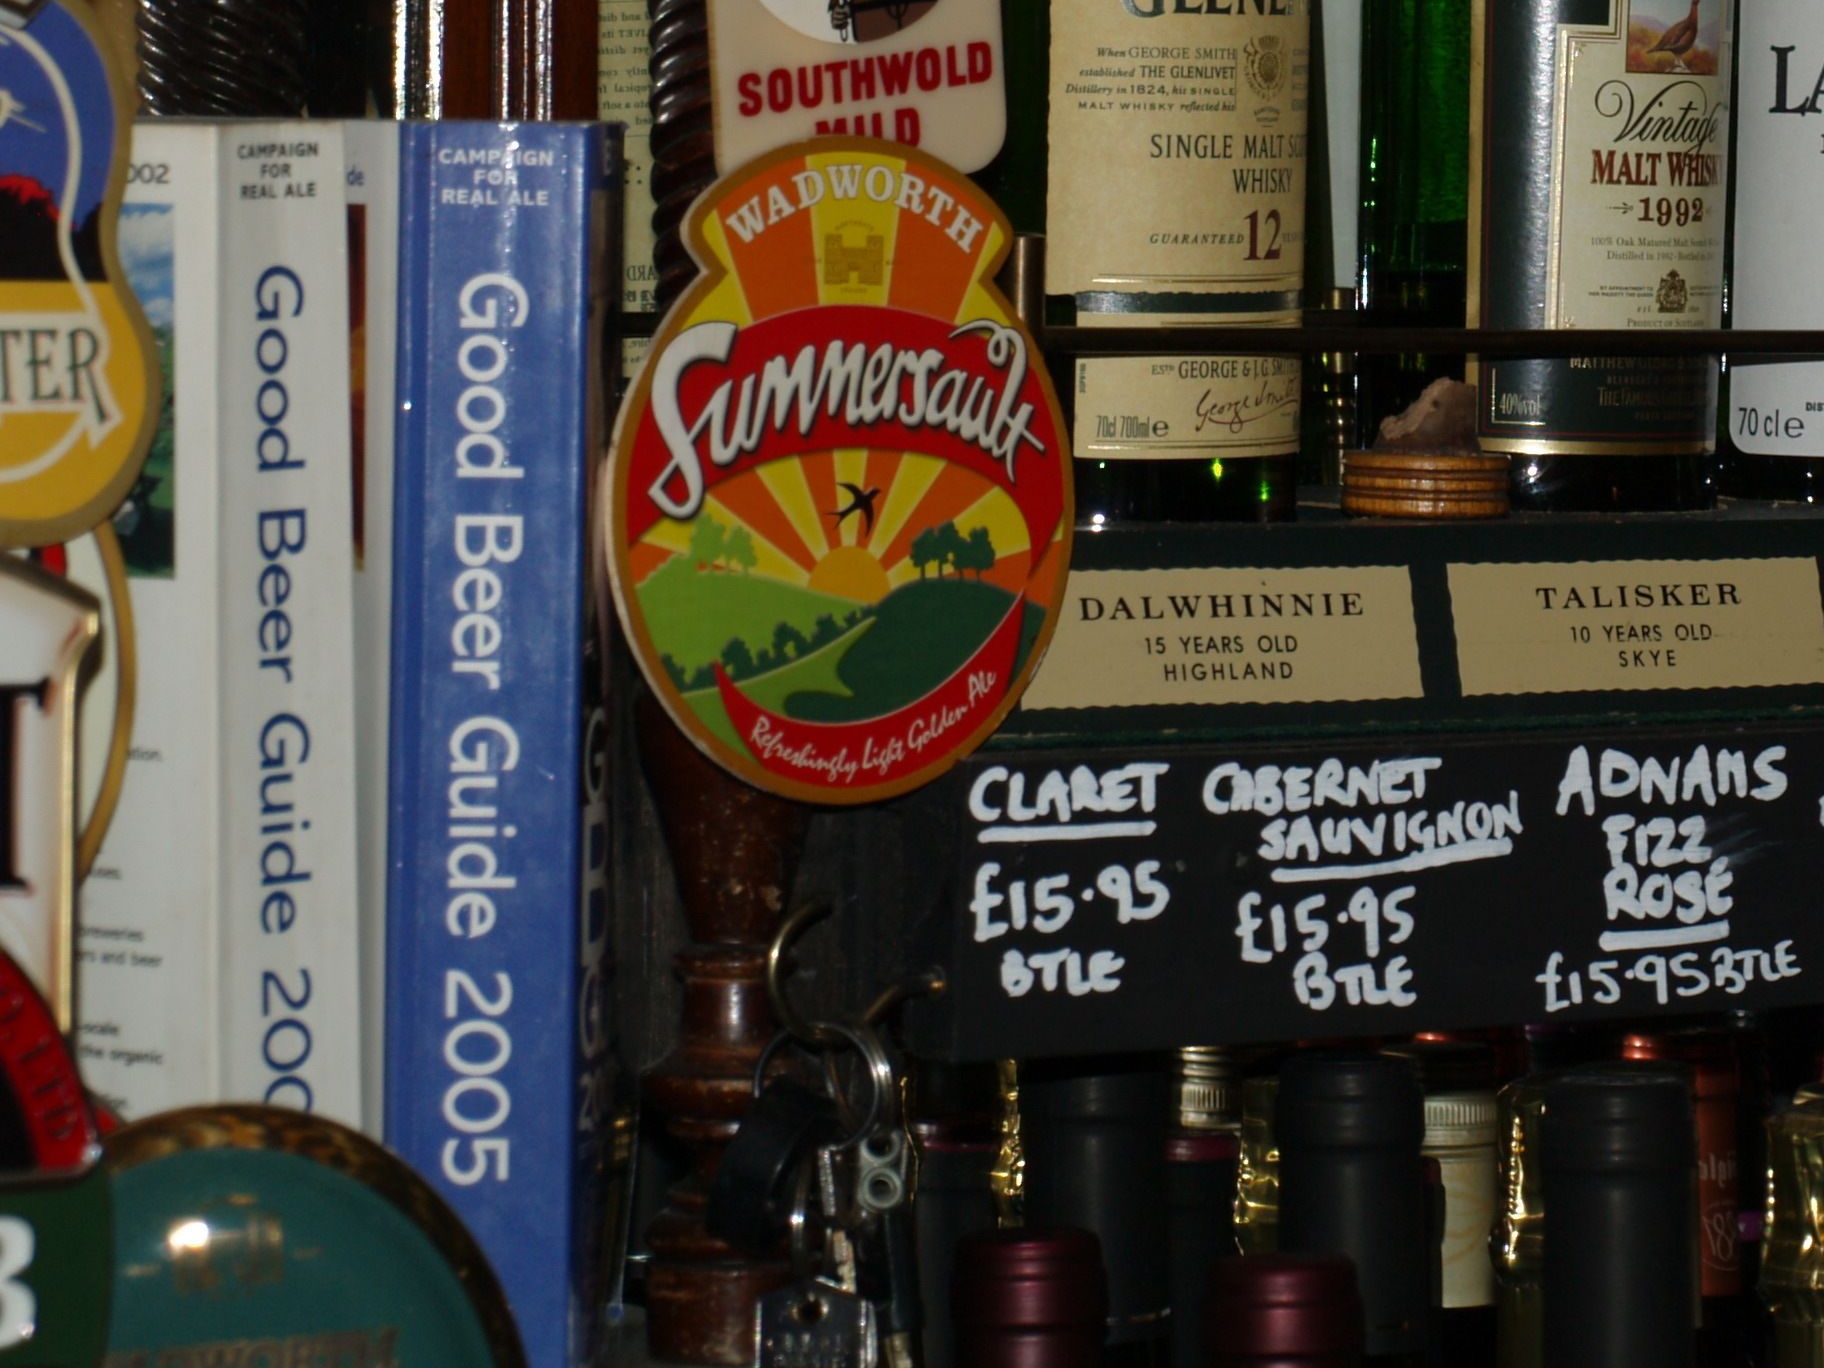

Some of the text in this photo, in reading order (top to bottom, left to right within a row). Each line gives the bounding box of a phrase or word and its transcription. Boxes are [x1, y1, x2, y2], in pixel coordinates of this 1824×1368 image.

[738, 41, 994, 117] SOUTHWOLD
[1128, 47, 1236, 59] GEORGE SMITH
[1140, 66, 1236, 79] THE GLENLIVET
[1595, 79, 1720, 153] Vintage
[439, 150, 553, 167] CAMPAIGN
[1150, 134, 1284, 159] SINGLE MALT
[1591, 149, 1660, 185] MALT
[442, 189, 549, 207] REAL ALE
[474, 169, 517, 184] FOR
[1233, 168, 1294, 193] WHISKY
[725, 164, 984, 253] WADWORTH
[1150, 209, 1282, 261] GUARANTEED 12
[1638, 196, 1705, 227] 1992
[647, 319, 1046, 519] Summersault
[256, 264, 311, 933] Good Beer Guide
[1080, 592, 1364, 621] DALWHINNIE
[1536, 582, 1740, 609] TALISKER
[1144, 633, 1298, 654] 15 YEARS OLD
[1570, 622, 1712, 643] 10 YEARS OLD
[1619, 649, 1677, 668] SKYE
[1162, 659, 1293, 681] HIGHLAND
[442, 272, 529, 1185] Good Beer Guide 2005
[749, 670, 998, 781] Refreshingly Light Golden Ale
[969, 762, 1169, 822] CLARET
[1203, 758, 1441, 815] CABERNET
[1556, 744, 1788, 816] ADNAMS
[1257, 791, 1523, 862] SAUVIGNON
[1602, 813, 1712, 867] FIZZ
[969, 860, 1169, 942] £15.95
[1602, 856, 1734, 923] ROSÉ
[1235, 885, 1416, 963] £15.95
[1000, 949, 1125, 997] BTLE
[1293, 951, 1417, 1011] BTLE
[1536, 939, 1801, 1011] £15.95 BTLE
